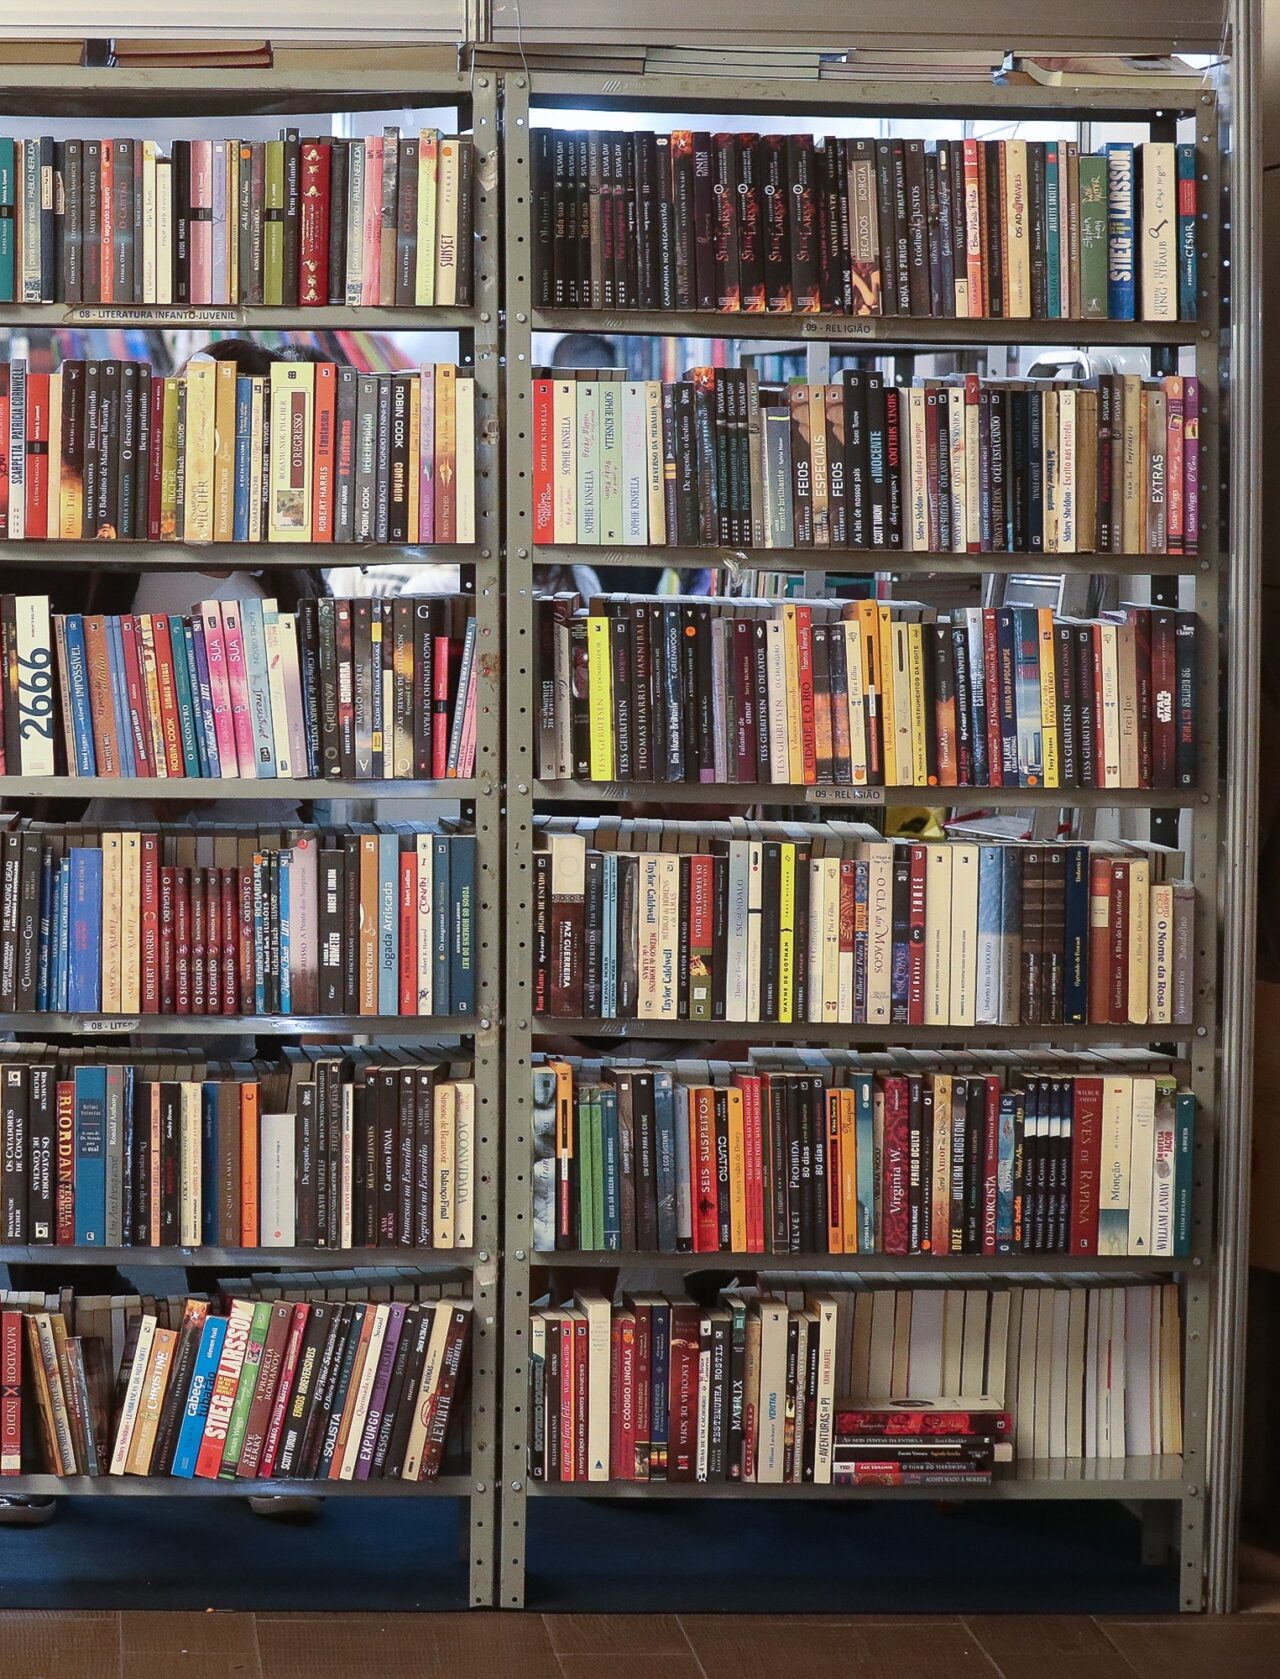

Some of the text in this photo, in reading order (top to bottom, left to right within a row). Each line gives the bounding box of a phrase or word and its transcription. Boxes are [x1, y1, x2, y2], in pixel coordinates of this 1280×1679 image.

[1108, 150, 1131, 281] STIEG LARSSON
[440, 234, 453, 267] SUNSET
[1184, 222, 1194, 257] CÉSAR
[79, 310, 90, 318] 08
[98, 310, 153, 319] LITERATURA
[155, 311, 236, 320] INFANTO-JUVENIL
[806, 324, 817, 332] 09
[11, 368, 24, 484] SCARPETTA PATRICIA CORNWELL
[100, 398, 110, 433] Blavatsky
[293, 413, 303, 457] REGRESSO
[797, 461, 809, 497] FEIOS
[815, 435, 826, 497] ESPECIAIS
[832, 462, 843, 497] FEIOS
[1152, 454, 1163, 503] EXTRAS
[99, 476, 108, 508] Babuíno
[212, 640, 221, 662] SUA
[18, 648, 53, 740] 2666
[340, 662, 351, 703] GOMORRA
[636, 623, 647, 770] THOMAS HARRIS HANNIBAL
[1163, 691, 1172, 722] WARS
[167, 718, 178, 771] ROBIN COOK
[815, 790, 826, 798] 09
[913, 878, 923, 912] THREE
[146, 929, 154, 963] HARRIS
[383, 882, 394, 970] Jogada Arriscada
[146, 966, 154, 1000] ROBERT
[662, 949, 672, 1012] Taylor Caldwell
[1156, 921, 1167, 1007] O Nome da Rosa
[5, 1110, 14, 1172] OS CATADORES
[719, 1136, 728, 1181] QUATRO
[16, 1160, 22, 1172] DE
[952, 1118, 965, 1250] DOZE WILLIAM GLADSTONE
[983, 1175, 996, 1245] O EXORCISTA
[5, 1327, 18, 1435] MATADOR ÍNDIO
[204, 1301, 253, 1439] STIEG LARSSON
[186, 1375, 205, 1416] cabeça
[195, 1372, 216, 1417] tubarão
[623, 1387, 632, 1420] CÓDIGO
[323, 1413, 341, 1457] SOLISTA
[360, 1410, 380, 1460] EXPURGO
[431, 1396, 450, 1442] LEVIATÃ
